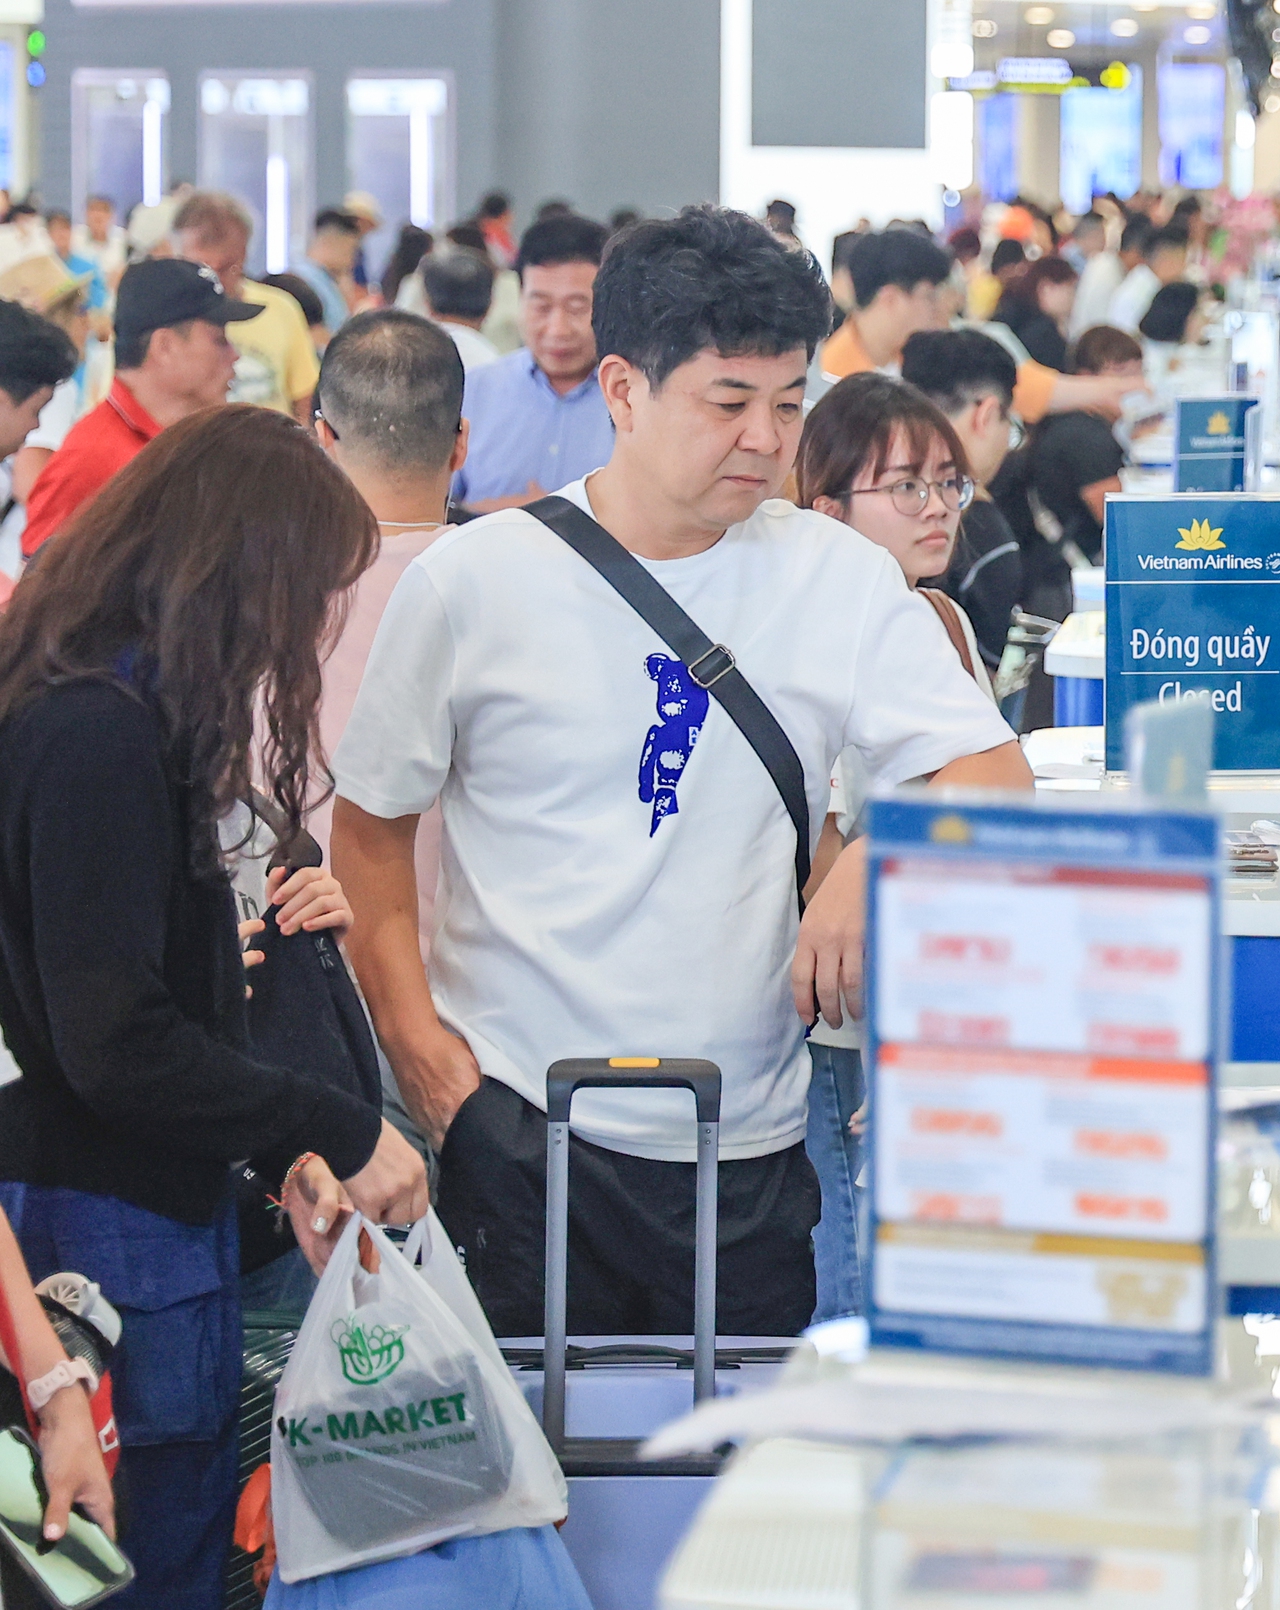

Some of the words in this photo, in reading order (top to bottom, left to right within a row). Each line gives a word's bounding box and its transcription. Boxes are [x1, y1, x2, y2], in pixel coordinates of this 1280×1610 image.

[1137, 554, 1201, 570] Vietnam
[1203, 553, 1264, 570] Airlines
[1129, 628, 1200, 667] Đóng
[1207, 625, 1271, 667] quầy
[288, 1392, 466, 1447] K-MARKET
